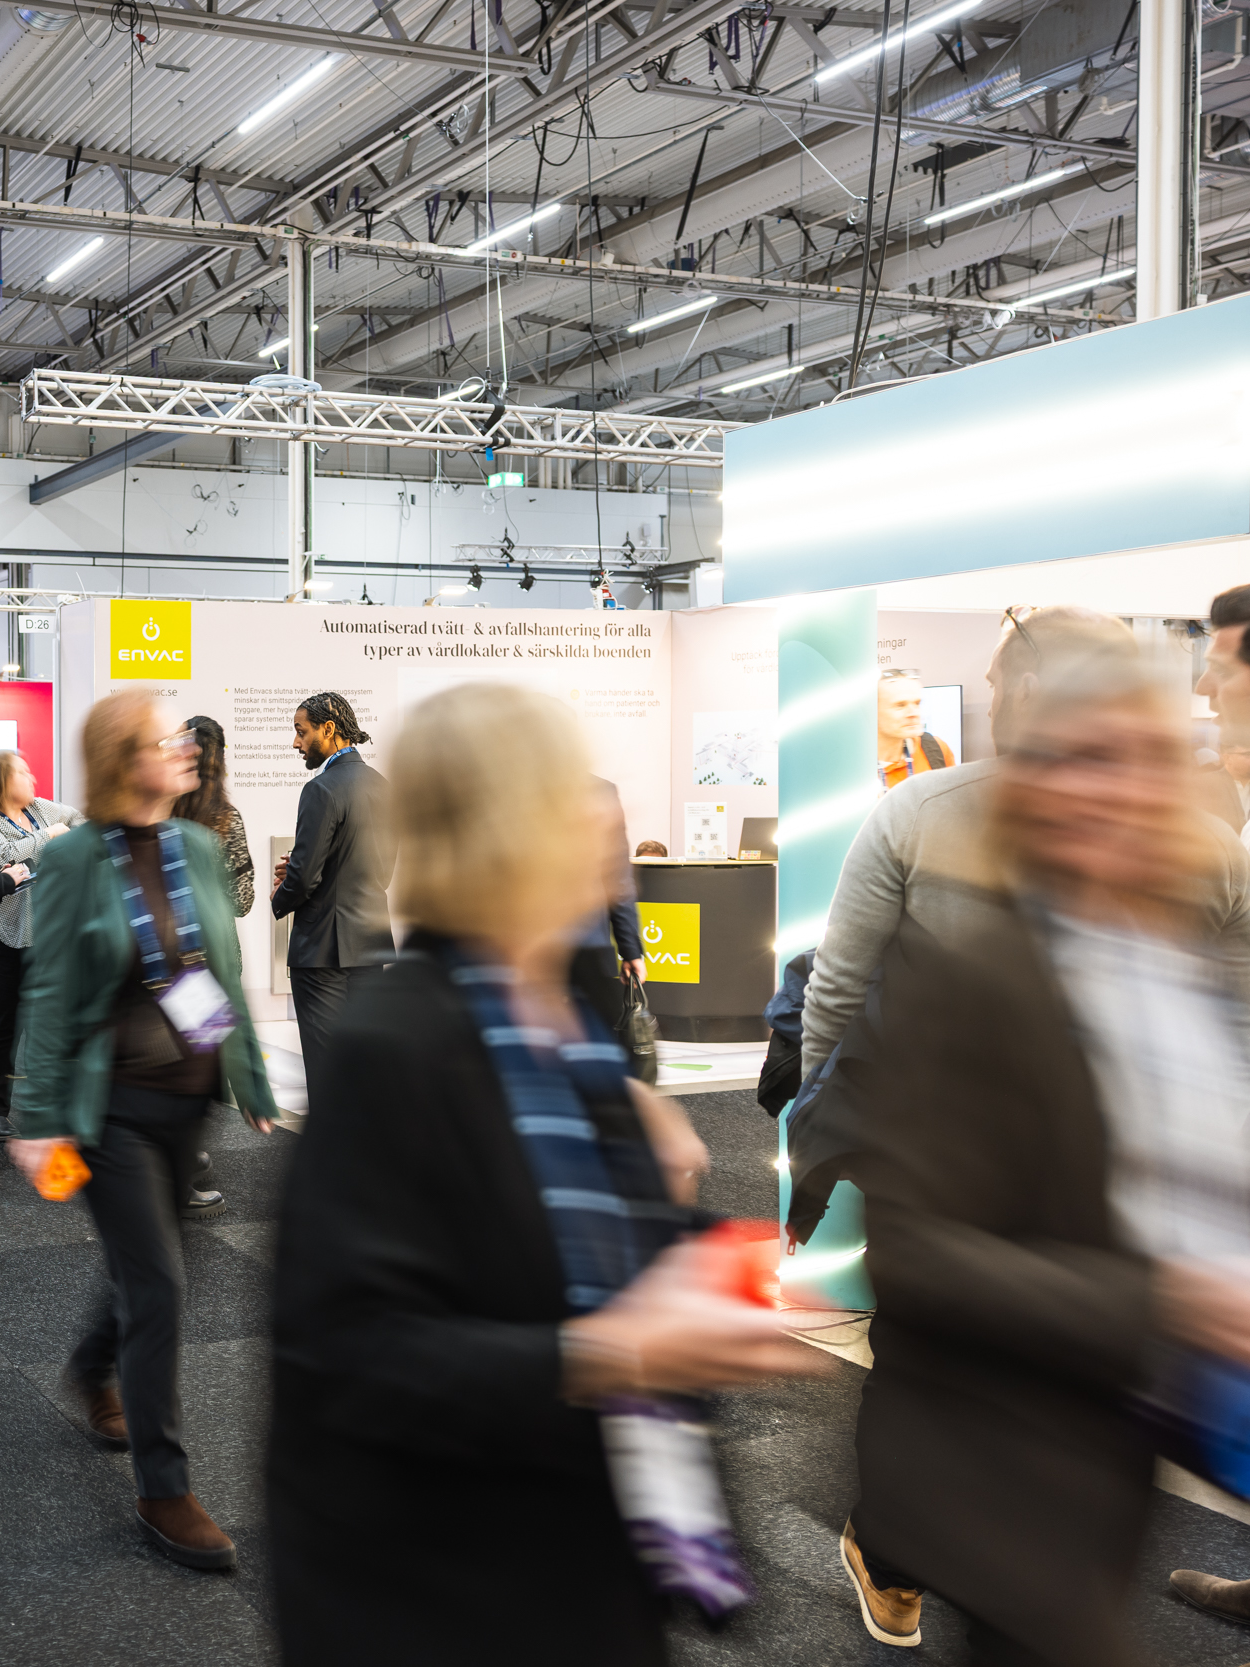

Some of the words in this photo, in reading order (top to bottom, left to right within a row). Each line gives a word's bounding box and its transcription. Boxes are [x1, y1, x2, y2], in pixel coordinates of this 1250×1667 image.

[25, 619, 50, 630] D:26
[319, 619, 428, 635] Automatiserad
[431, 620, 470, 635] tvätt-
[473, 621, 485, 636] &
[488, 621, 601, 640] avfallshantering
[604, 623, 624, 637] för
[627, 623, 651, 637] alla
[363, 643, 403, 660] typer
[406, 646, 423, 657] av
[427, 641, 510, 658] vårdlokaler
[512, 644, 524, 658] &
[527, 643, 590, 658] särskilda
[593, 645, 651, 658] boenden
[118, 649, 184, 662] ENVAC
[234, 687, 249, 695] Med
[250, 687, 273, 695] Envacs
[273, 687, 293, 695] slutna
[294, 687, 311, 695] tvätt-
[584, 689, 607, 697] Varma
[633, 688, 646, 697] ska
[647, 689, 655, 697] ta
[616, 699, 646, 708] patienter
[647, 699, 661, 707] och
[234, 706, 262, 714] tryggare,
[613, 710, 627, 718] inte
[256, 715, 285, 724] systemet
[234, 724, 265, 732] fraktioner
[234, 752, 271, 760] kontaktlösa
[272, 753, 296, 761] system
[257, 771, 271, 779] lukt,
[618, 952, 690, 965] VAC
